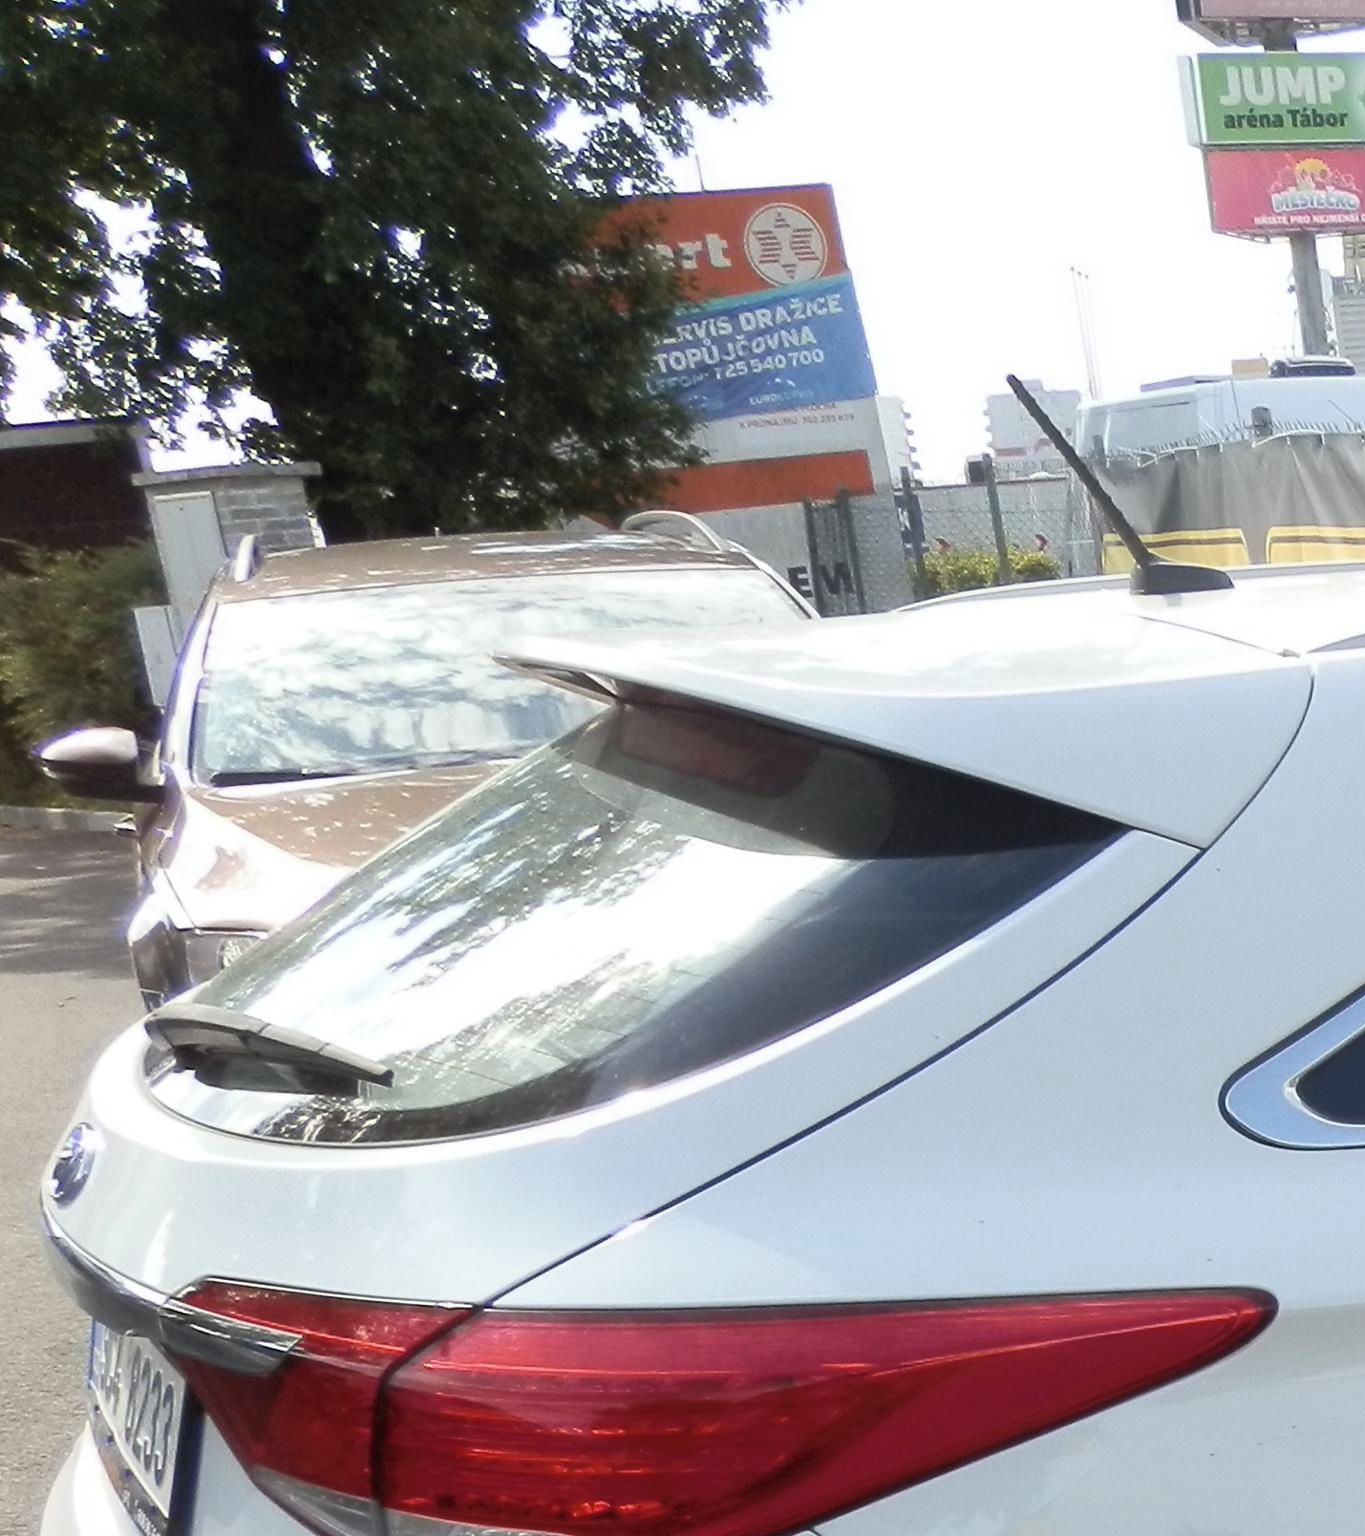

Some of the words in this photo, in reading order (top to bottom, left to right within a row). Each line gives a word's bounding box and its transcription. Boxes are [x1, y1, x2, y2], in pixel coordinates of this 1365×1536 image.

[1220, 66, 1346, 106] JUMP
[1224, 109, 1284, 129] aréna
[1288, 107, 1348, 128] Tábor
[1290, 215, 1311, 224] PRO
[652, 314, 733, 347] RVIS
[740, 293, 843, 332] DRAŽICE
[650, 325, 817, 374] TOPŮJČOVNA
[753, 355, 786, 374] 540
[791, 349, 825, 368] 700
[125, 1345, 175, 1487] 8233
